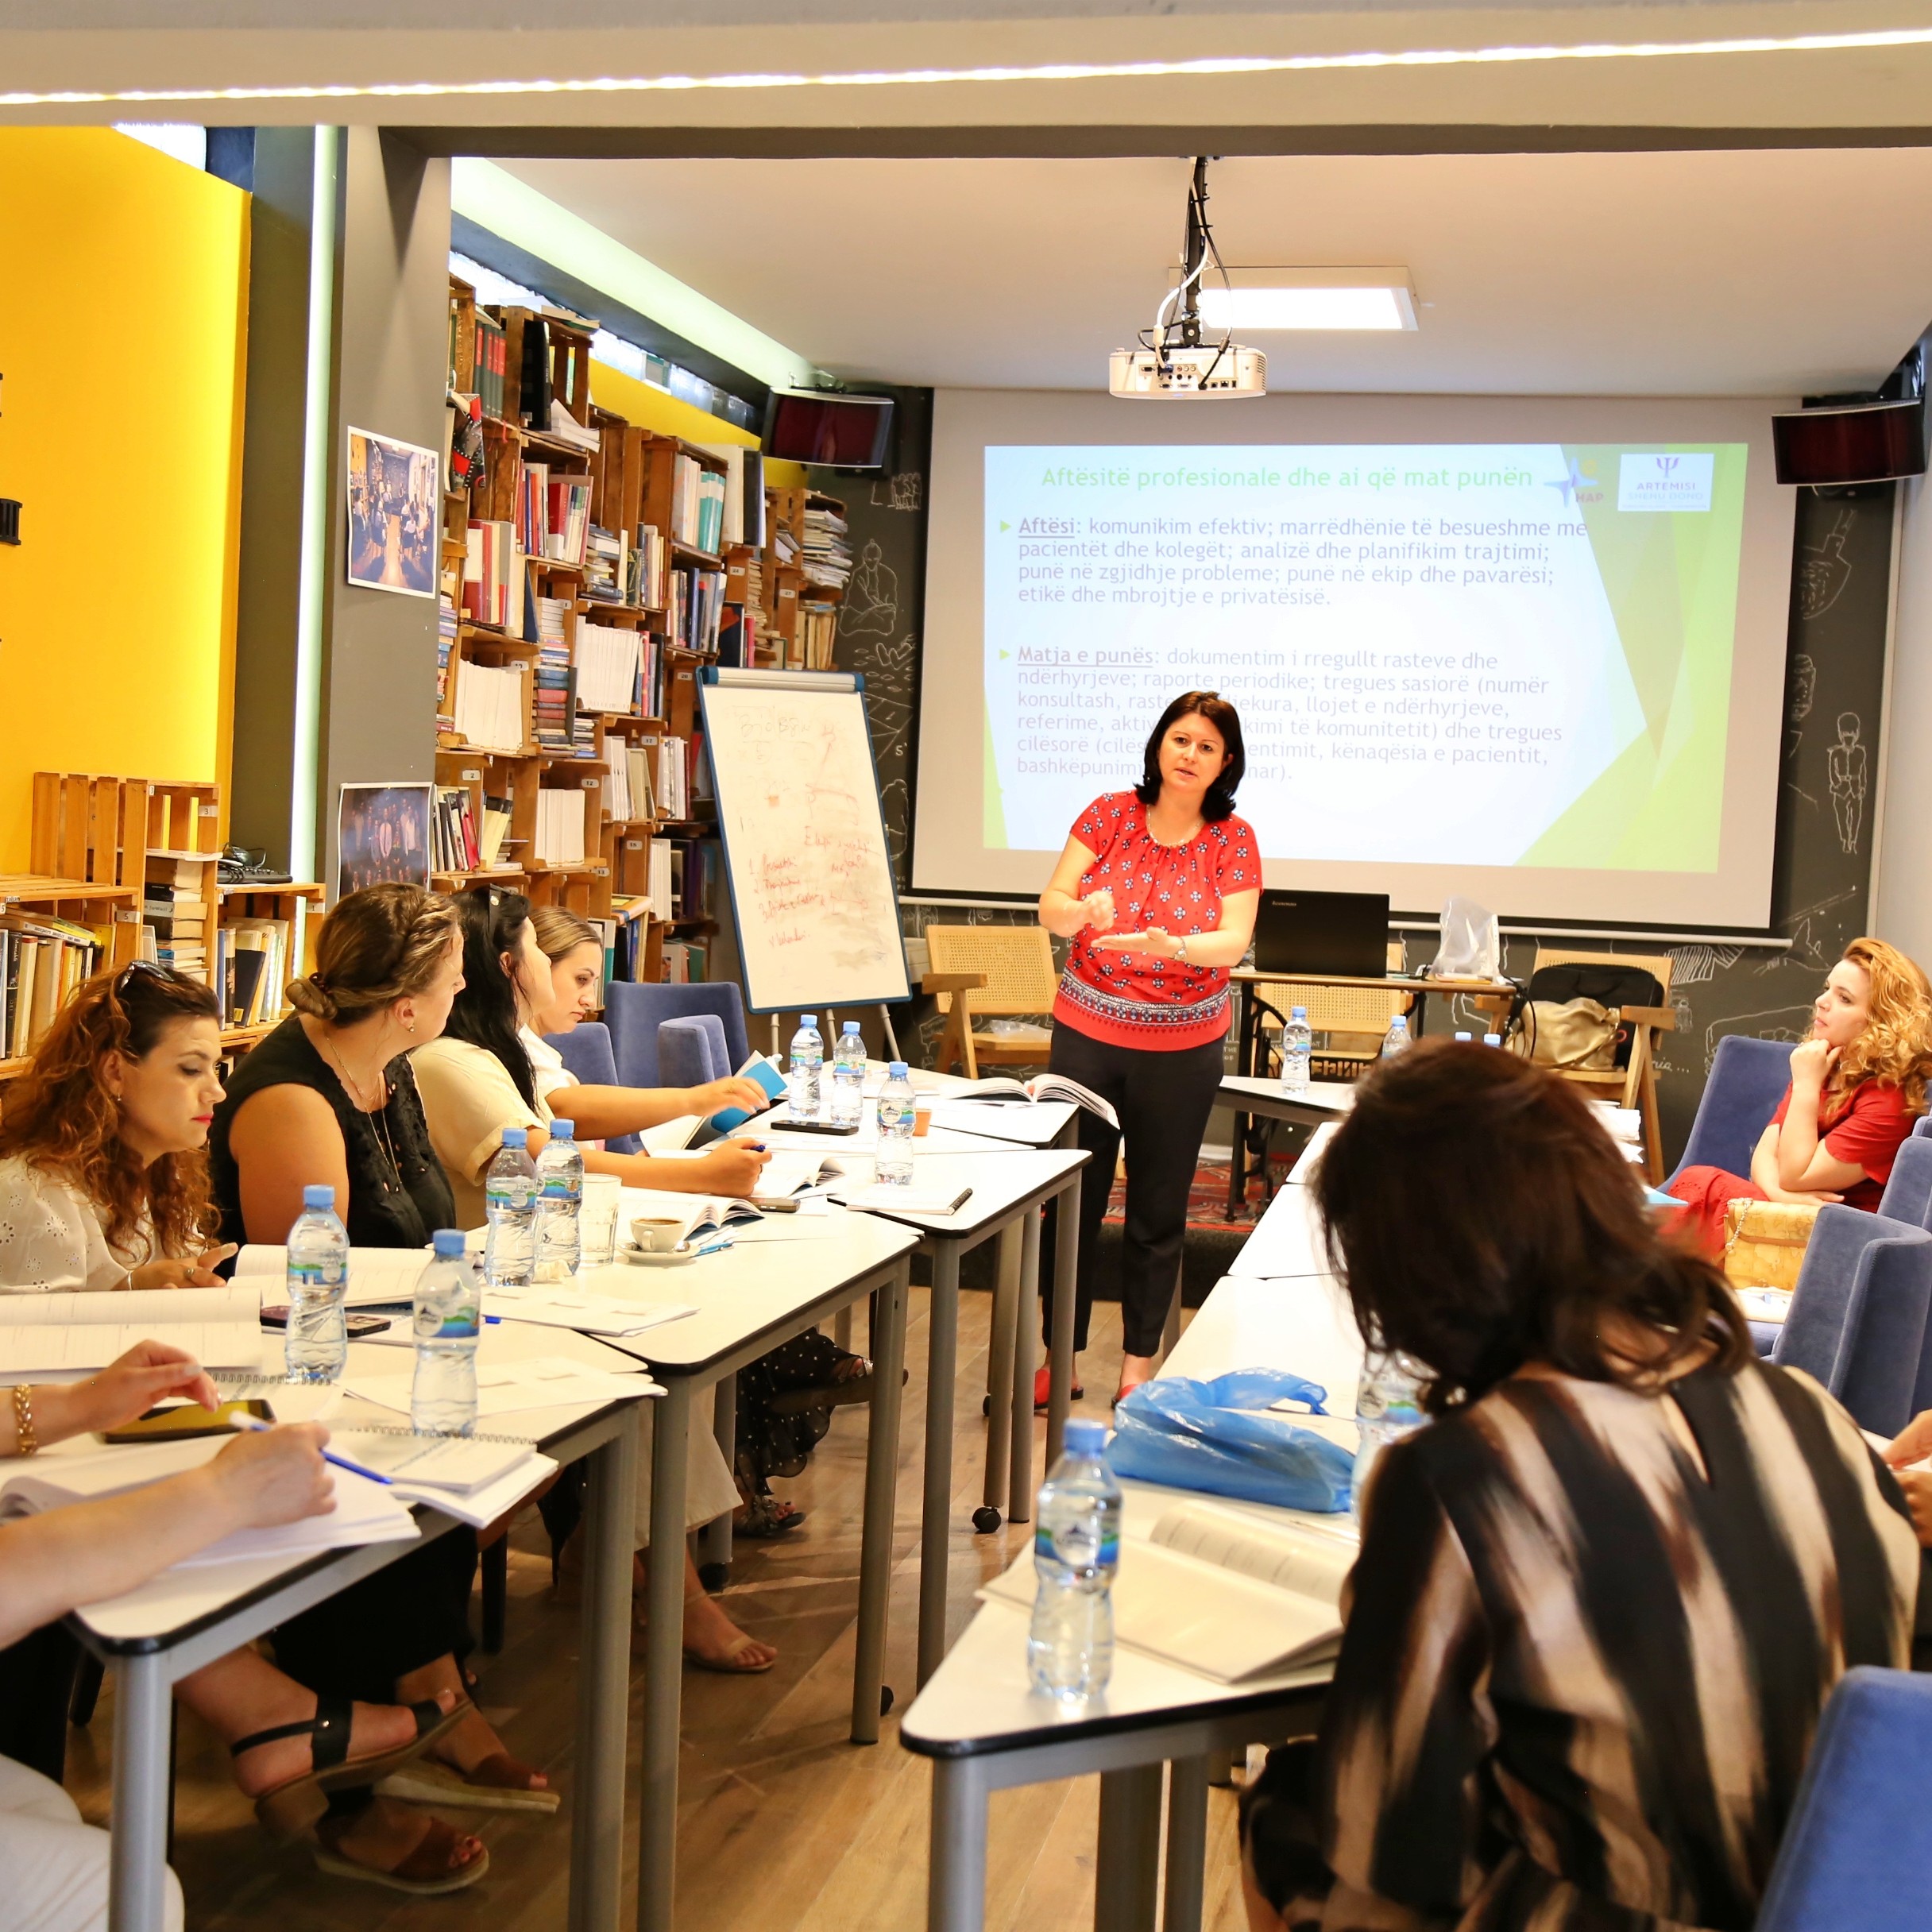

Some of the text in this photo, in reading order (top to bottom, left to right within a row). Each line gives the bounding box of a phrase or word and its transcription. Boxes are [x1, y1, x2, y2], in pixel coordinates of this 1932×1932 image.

[1041, 466, 1533, 493] Aftësitë profesionale dhe ai që mat punën
[1636, 482, 1696, 491] ARTEMISI
[1018, 516, 1588, 539] Aftësi: komunikim efektiv; marrëdhënie të besueshme me
[1018, 539, 1549, 565] pacientët dhe kolegët; analizë dhe planifikim trajtimi;
[1018, 561, 1554, 587] punë në zgjidhje probleme; punë në ekip dhe pavarësi;
[1018, 584, 1331, 609] etikë dhe mbrojtje e privatësisë.
[1017, 646, 1072, 666] Matja
[1076, 650, 1089, 663] e
[1095, 647, 1161, 667] punës:
[1166, 647, 1285, 666] dokumentim
[1383, 652, 1457, 670] rasteve
[1461, 651, 1498, 670] dhe
[1018, 667, 1550, 696] ndërhyrjeve; raporte periodike; tregues sasiorë (numër
[1018, 690, 1121, 712] konsultash,
[1306, 695, 1358, 717] llojet
[1364, 701, 1377, 714] e
[1383, 697, 1509, 721] ndërhyrjeve,
[1018, 713, 1105, 734] referime,
[1289, 718, 1310, 736] të
[1316, 718, 1438, 741] komunitetit)
[1444, 721, 1482, 740] dhe
[1487, 724, 1563, 744] tregues
[1017, 734, 1089, 753] cilësorë
[1247, 740, 1323, 761] entimit,
[1331, 741, 1428, 764] kënaqësia
[1433, 748, 1446, 762] e
[1451, 745, 1548, 767] pacientit,
[1248, 764, 1293, 782] nar).
